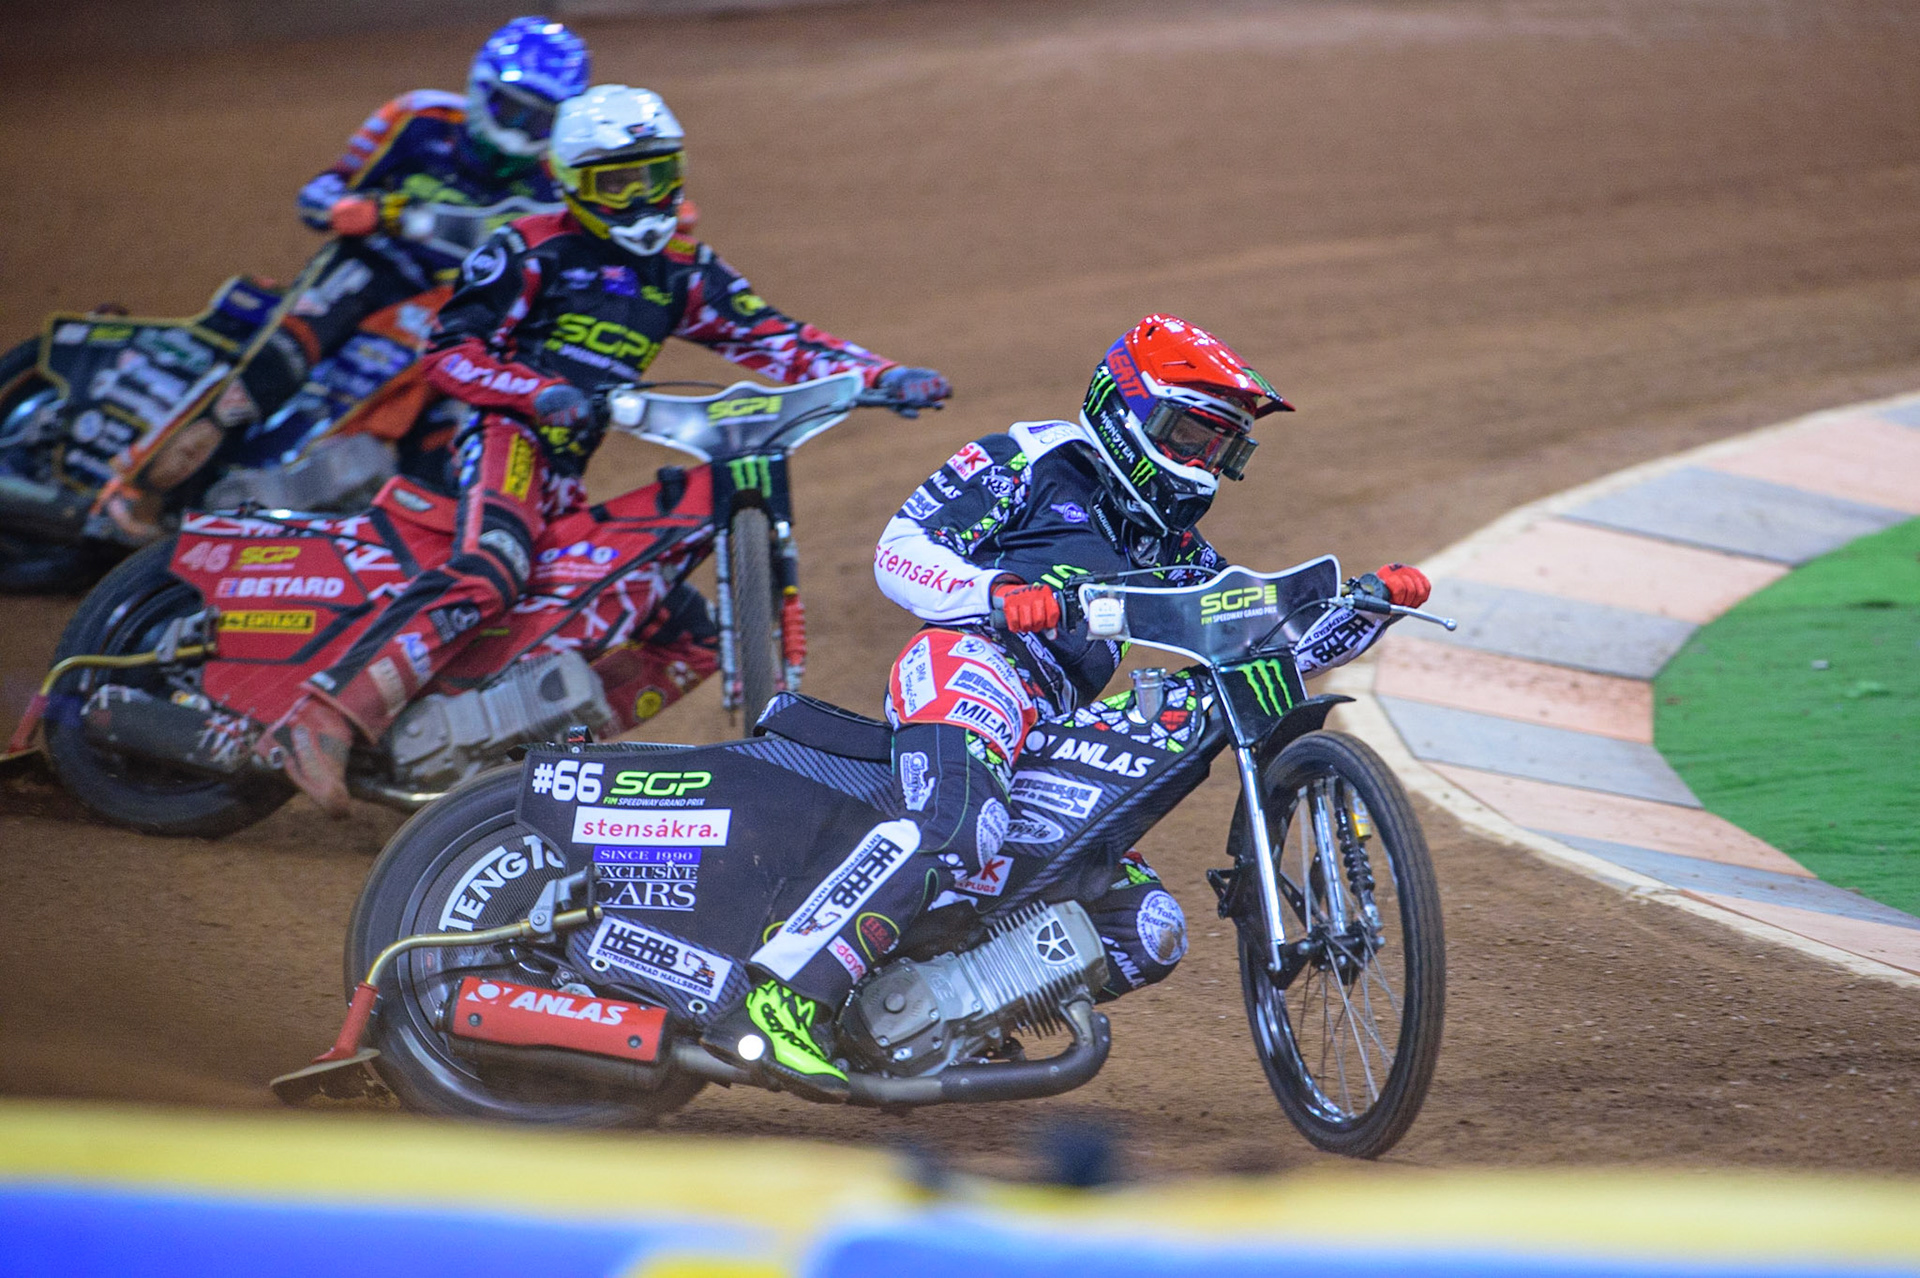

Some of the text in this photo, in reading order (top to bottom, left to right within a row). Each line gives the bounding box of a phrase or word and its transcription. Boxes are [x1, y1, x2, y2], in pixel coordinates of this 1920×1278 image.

[239, 576, 344, 598] BETARD
[1213, 610, 1244, 623] SPEEDWAY
[1244, 608, 1264, 618] GRAND
[1264, 605, 1278, 615] PRIX
[1051, 738, 1156, 778] ANLAS
[532, 760, 604, 803] #66
[610, 771, 712, 796] SGP
[603, 796, 705, 806] FIM SPEEDWAY GRAND PRIX
[583, 818, 719, 838] stensåkra.
[600, 849, 693, 861] SINCE 1990
[599, 866, 698, 879] XCLUSIVE
[596, 948, 711, 996] ENTREPRENAD HALLSBERG
[509, 990, 629, 1025] ANLAS
